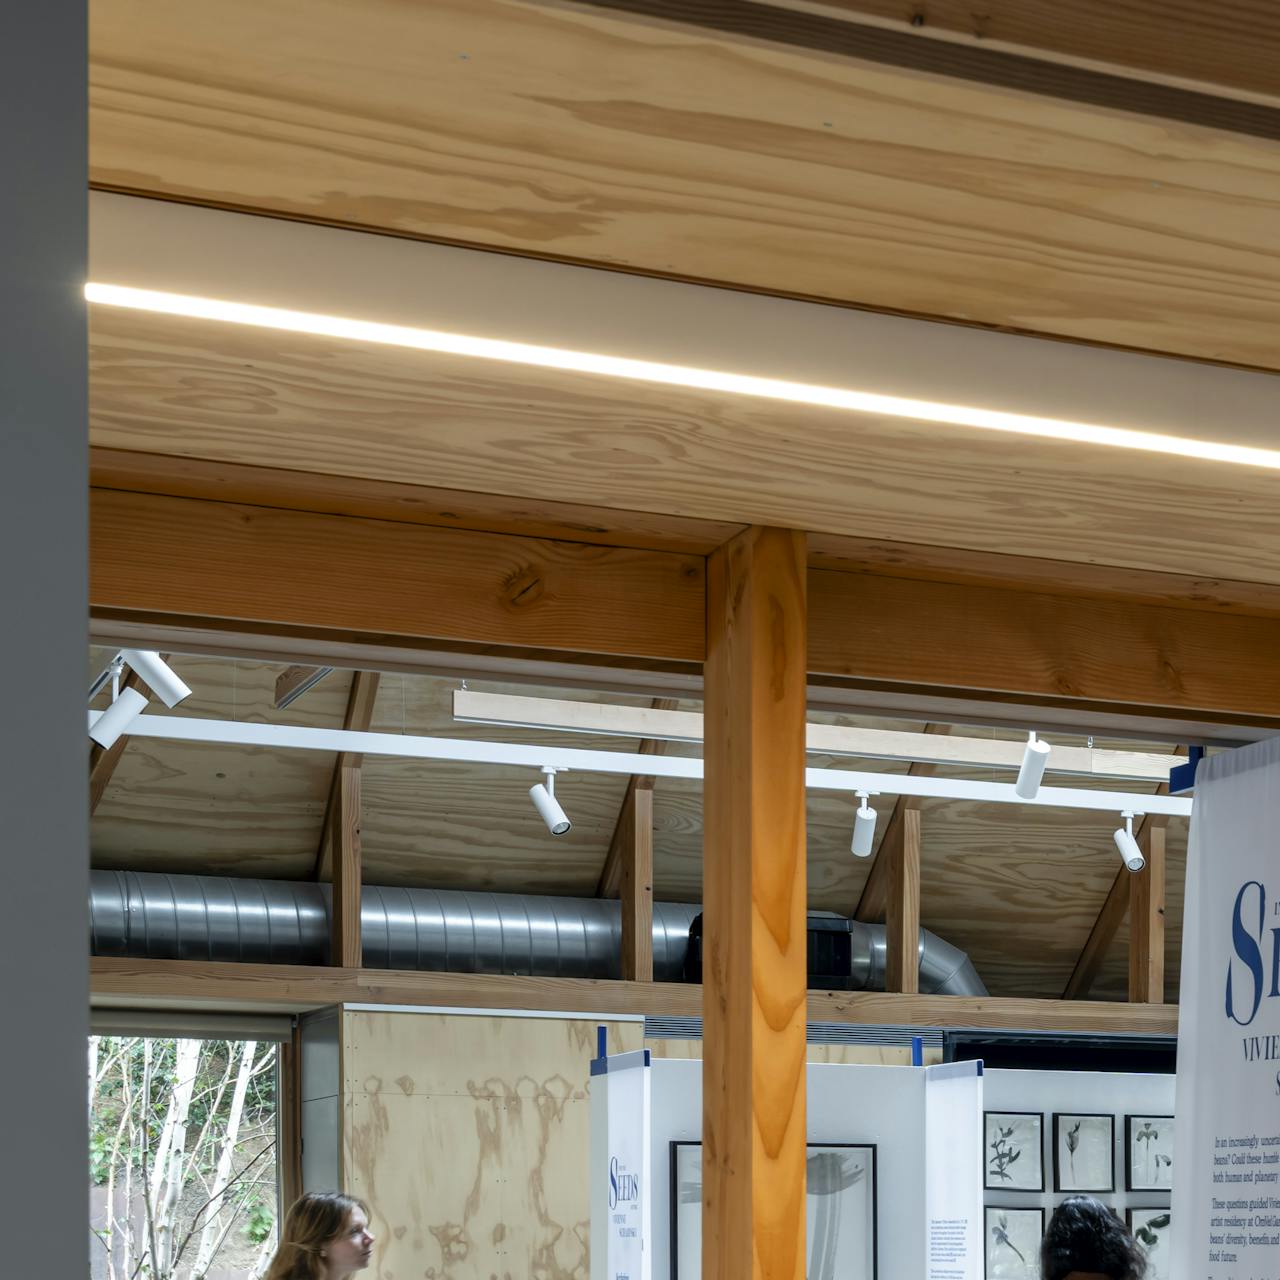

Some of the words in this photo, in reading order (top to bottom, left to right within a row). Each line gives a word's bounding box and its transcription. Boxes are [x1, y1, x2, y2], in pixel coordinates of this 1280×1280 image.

[1247, 1153, 1261, 1164] these
[609, 1156, 638, 1210] SEEDS
[1249, 1197, 1268, 1212] guided
